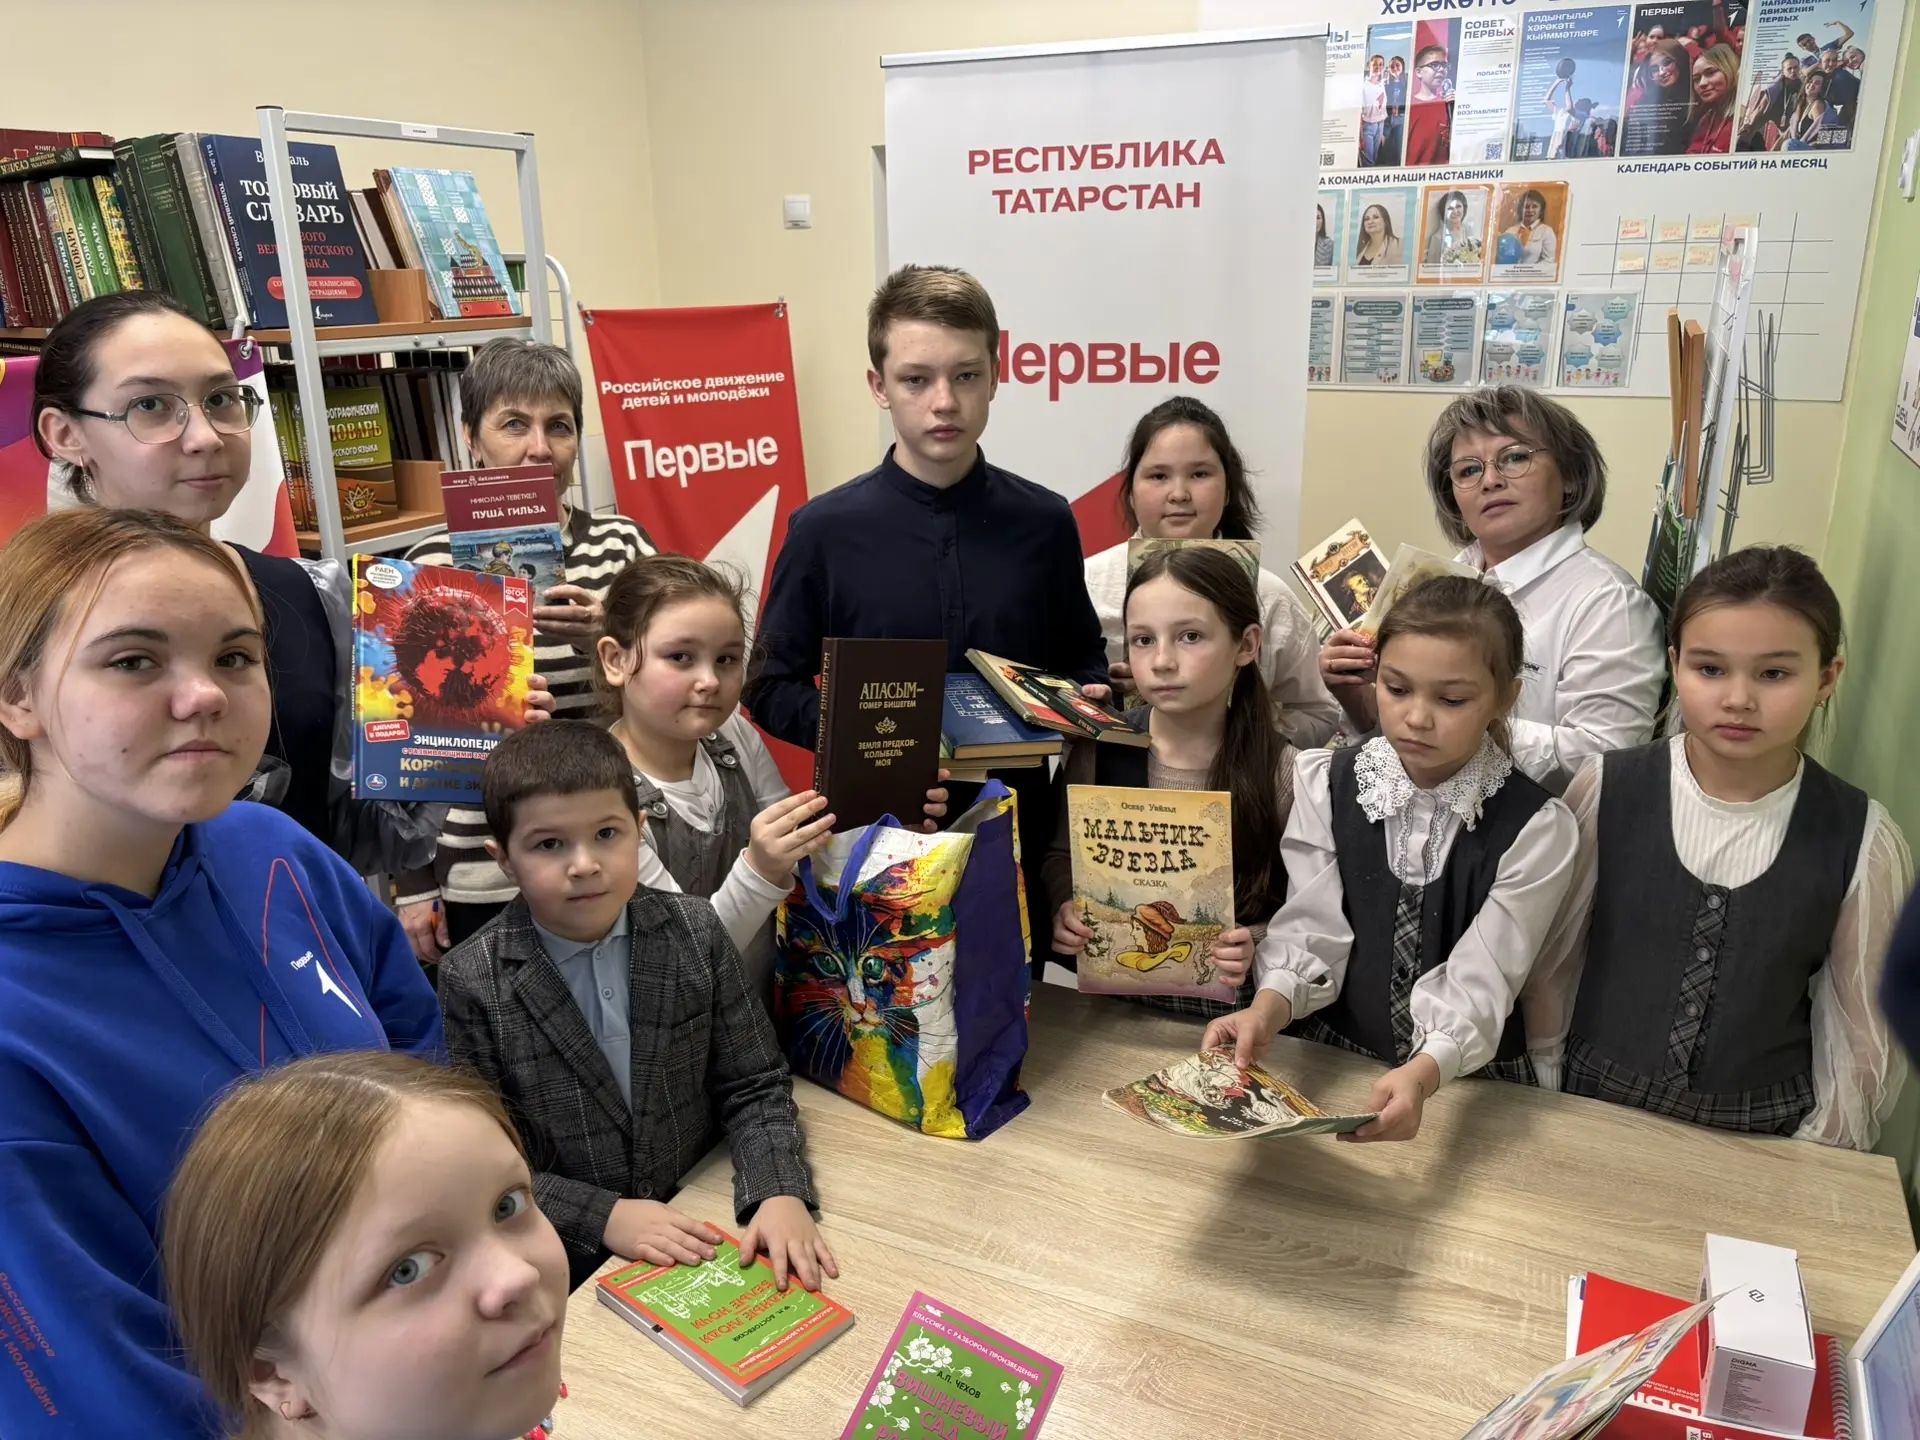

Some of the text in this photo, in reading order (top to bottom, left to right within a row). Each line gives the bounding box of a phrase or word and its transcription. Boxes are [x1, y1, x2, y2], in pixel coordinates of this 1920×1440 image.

[1528, 11, 1594, 23] АЛДЫНГЫЛАР
[1640, 6, 1685, 17] ПЕРВЫЕ
[1760, 6, 1815, 16] ДВИЖЕНИЯ
[1465, 19, 1505, 30] СОВЕТ
[1759, 15, 1799, 24] ПЕРВЫХ
[1464, 28, 1515, 39] ПЕРВЫХ
[289, 155, 310, 166] аль
[968, 138, 1226, 175] РЕСПУБЛИКА
[1617, 157, 1829, 174] КАЛЕНДАРЬ СОБЫТИЙ НА МЕСЯЦ
[1327, 172, 1381, 186] КОМАНДА
[1383, 172, 1391, 183] И
[1393, 171, 1426, 183] НАШИ
[1428, 169, 1505, 181] НАСТАВНИКИ
[240, 180, 339, 200] ТООВЫЙ
[992, 182, 1201, 214] ТАТАРСТАН
[246, 201, 344, 223] СЛВАРЬ
[77, 223, 95, 276] СЛОВАРЬ
[92, 222, 110, 276] СЛОВАРЬ
[230, 226, 244, 262] СЛОВАРЬ
[66, 227, 85, 280] СЛОВАРЬ
[600, 372, 785, 395] Российское движение
[621, 386, 770, 410] детей и молодёжи
[329, 420, 383, 442] ЛОВАРЬ
[624, 436, 779, 488] Первые
[470, 495, 505, 505] НИКОЛАЙ
[508, 504, 547, 517] ГИЛЬЗА
[374, 566, 395, 575] РАЕН
[505, 588, 527, 598] ФГОС
[859, 700, 917, 710] ГОМЕР БИШЕГЕМ
[373, 723, 401, 732] ДИПЛОМ
[375, 730, 406, 738] ПОДАРОК
[414, 735, 502, 751] ЭНЦИКЛОПЕДИ
[858, 741, 881, 750] ЗЕМЛЯ
[864, 750, 903, 759] КОЛЫБЕЛЬ
[875, 759, 891, 767] МОЯ
[1121, 802, 1177, 813] Оскар Уайльд
[1133, 878, 1168, 888] СКАЗКА
[691, 1279, 773, 1330] БЕЛЫЕ НОЧИ
[699, 1316, 744, 1345] ЛЮДИ
[733, 1314, 776, 1343] ДОСТОЕВСКИЙ
[912, 1311, 946, 1332] КЛАССИКА
[953, 1330, 989, 1356] РАЗБОРОМ
[989, 1350, 1039, 1381] ПРОИЗВЕДЕНИЙ
[1731, 1358, 1758, 1368] DIGMA
[936, 1371, 982, 1399] А.П. ЧЕХОВ
[893, 1370, 1009, 1440] ВИШНЕВЫЙ
[920, 1411, 960, 1440] САД
